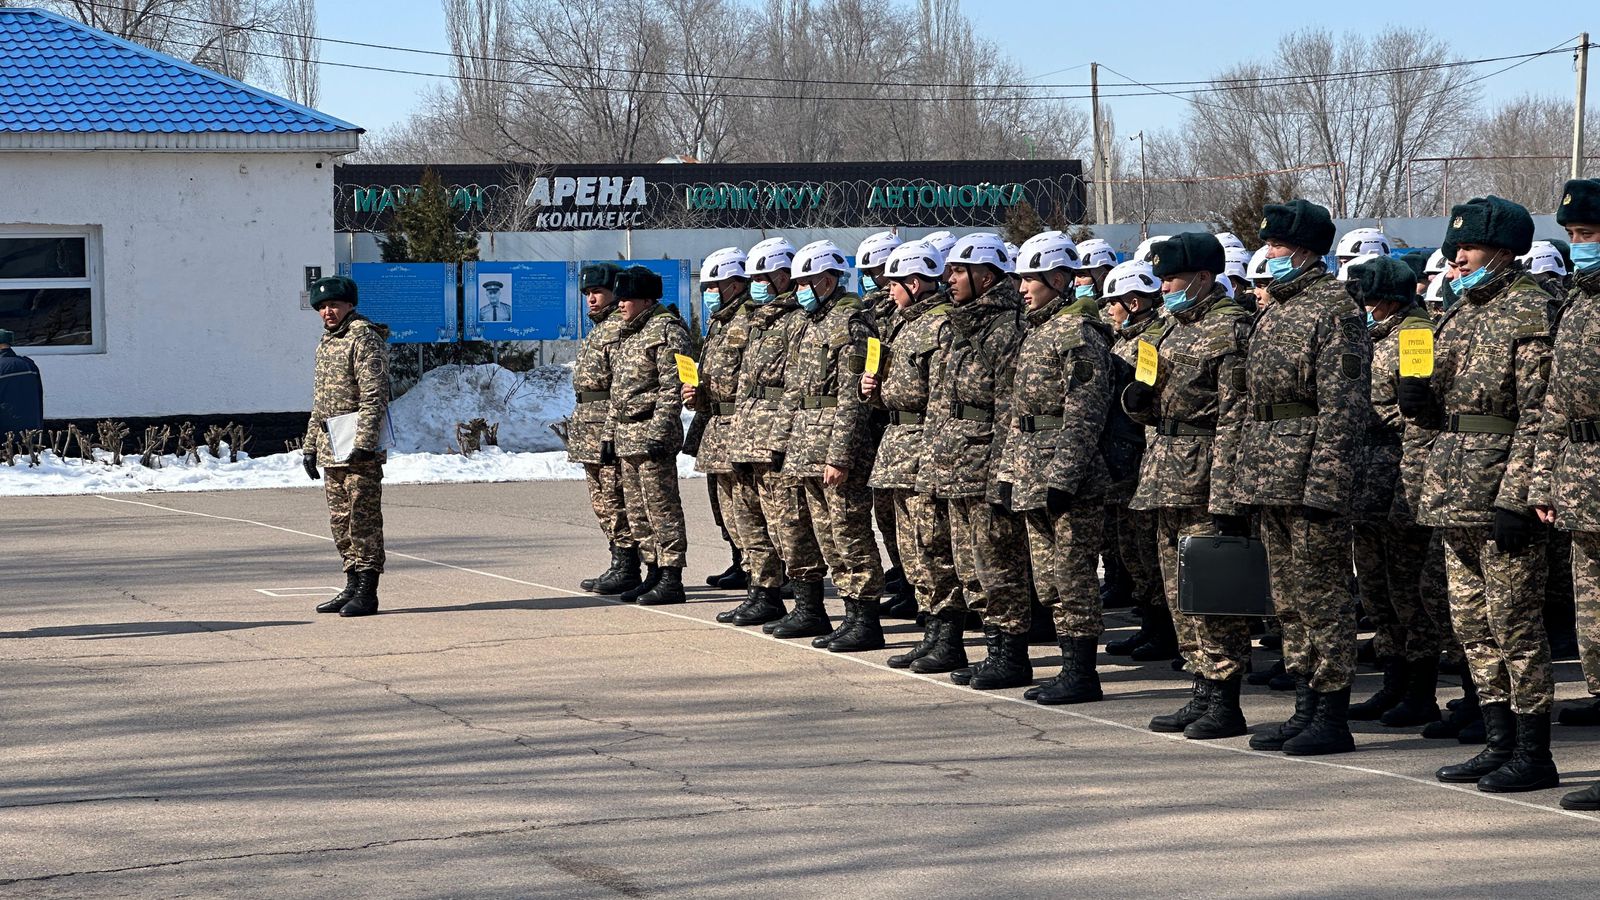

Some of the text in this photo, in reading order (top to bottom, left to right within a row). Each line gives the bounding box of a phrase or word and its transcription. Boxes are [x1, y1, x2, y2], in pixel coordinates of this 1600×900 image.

[525, 177, 648, 206] АРЕНА
[867, 182, 1025, 209] АВТОМОЙКА
[536, 211, 642, 227] КОМПЛЕКС
